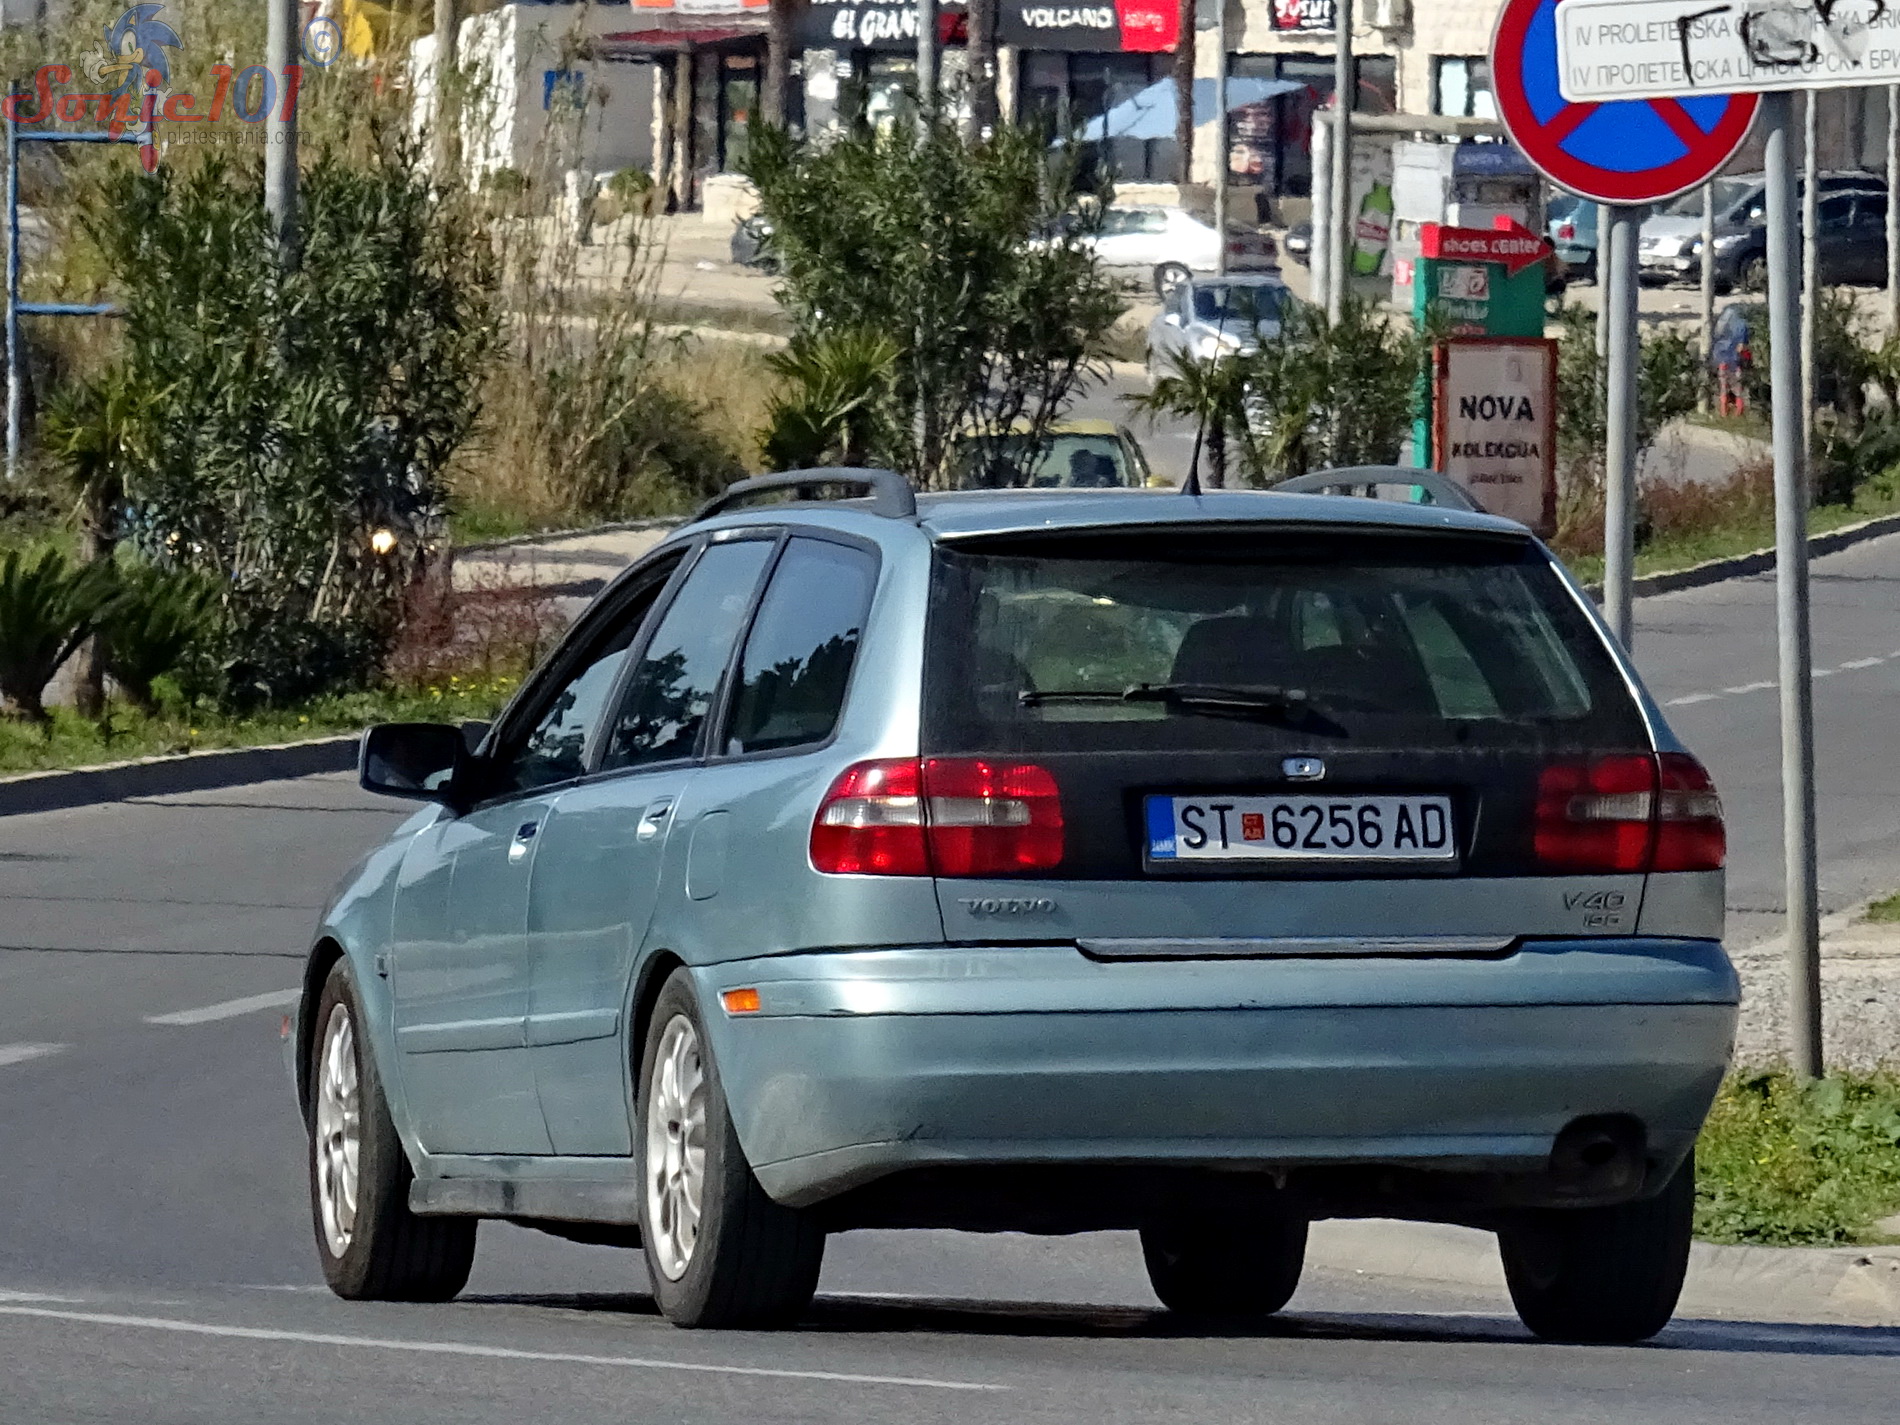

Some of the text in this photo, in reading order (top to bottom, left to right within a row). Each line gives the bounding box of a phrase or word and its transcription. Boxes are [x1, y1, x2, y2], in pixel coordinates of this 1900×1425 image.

[1022, 7, 1114, 29] VOLCANO
[1576, 26, 1592, 46] IV
[1443, 238, 1541, 255] shoes center
[1459, 395, 1535, 421] NOVA
[1181, 803, 1446, 849] ST 6256 AD
[958, 896, 1060, 914] VOLVO
[1562, 890, 1626, 911] V40
